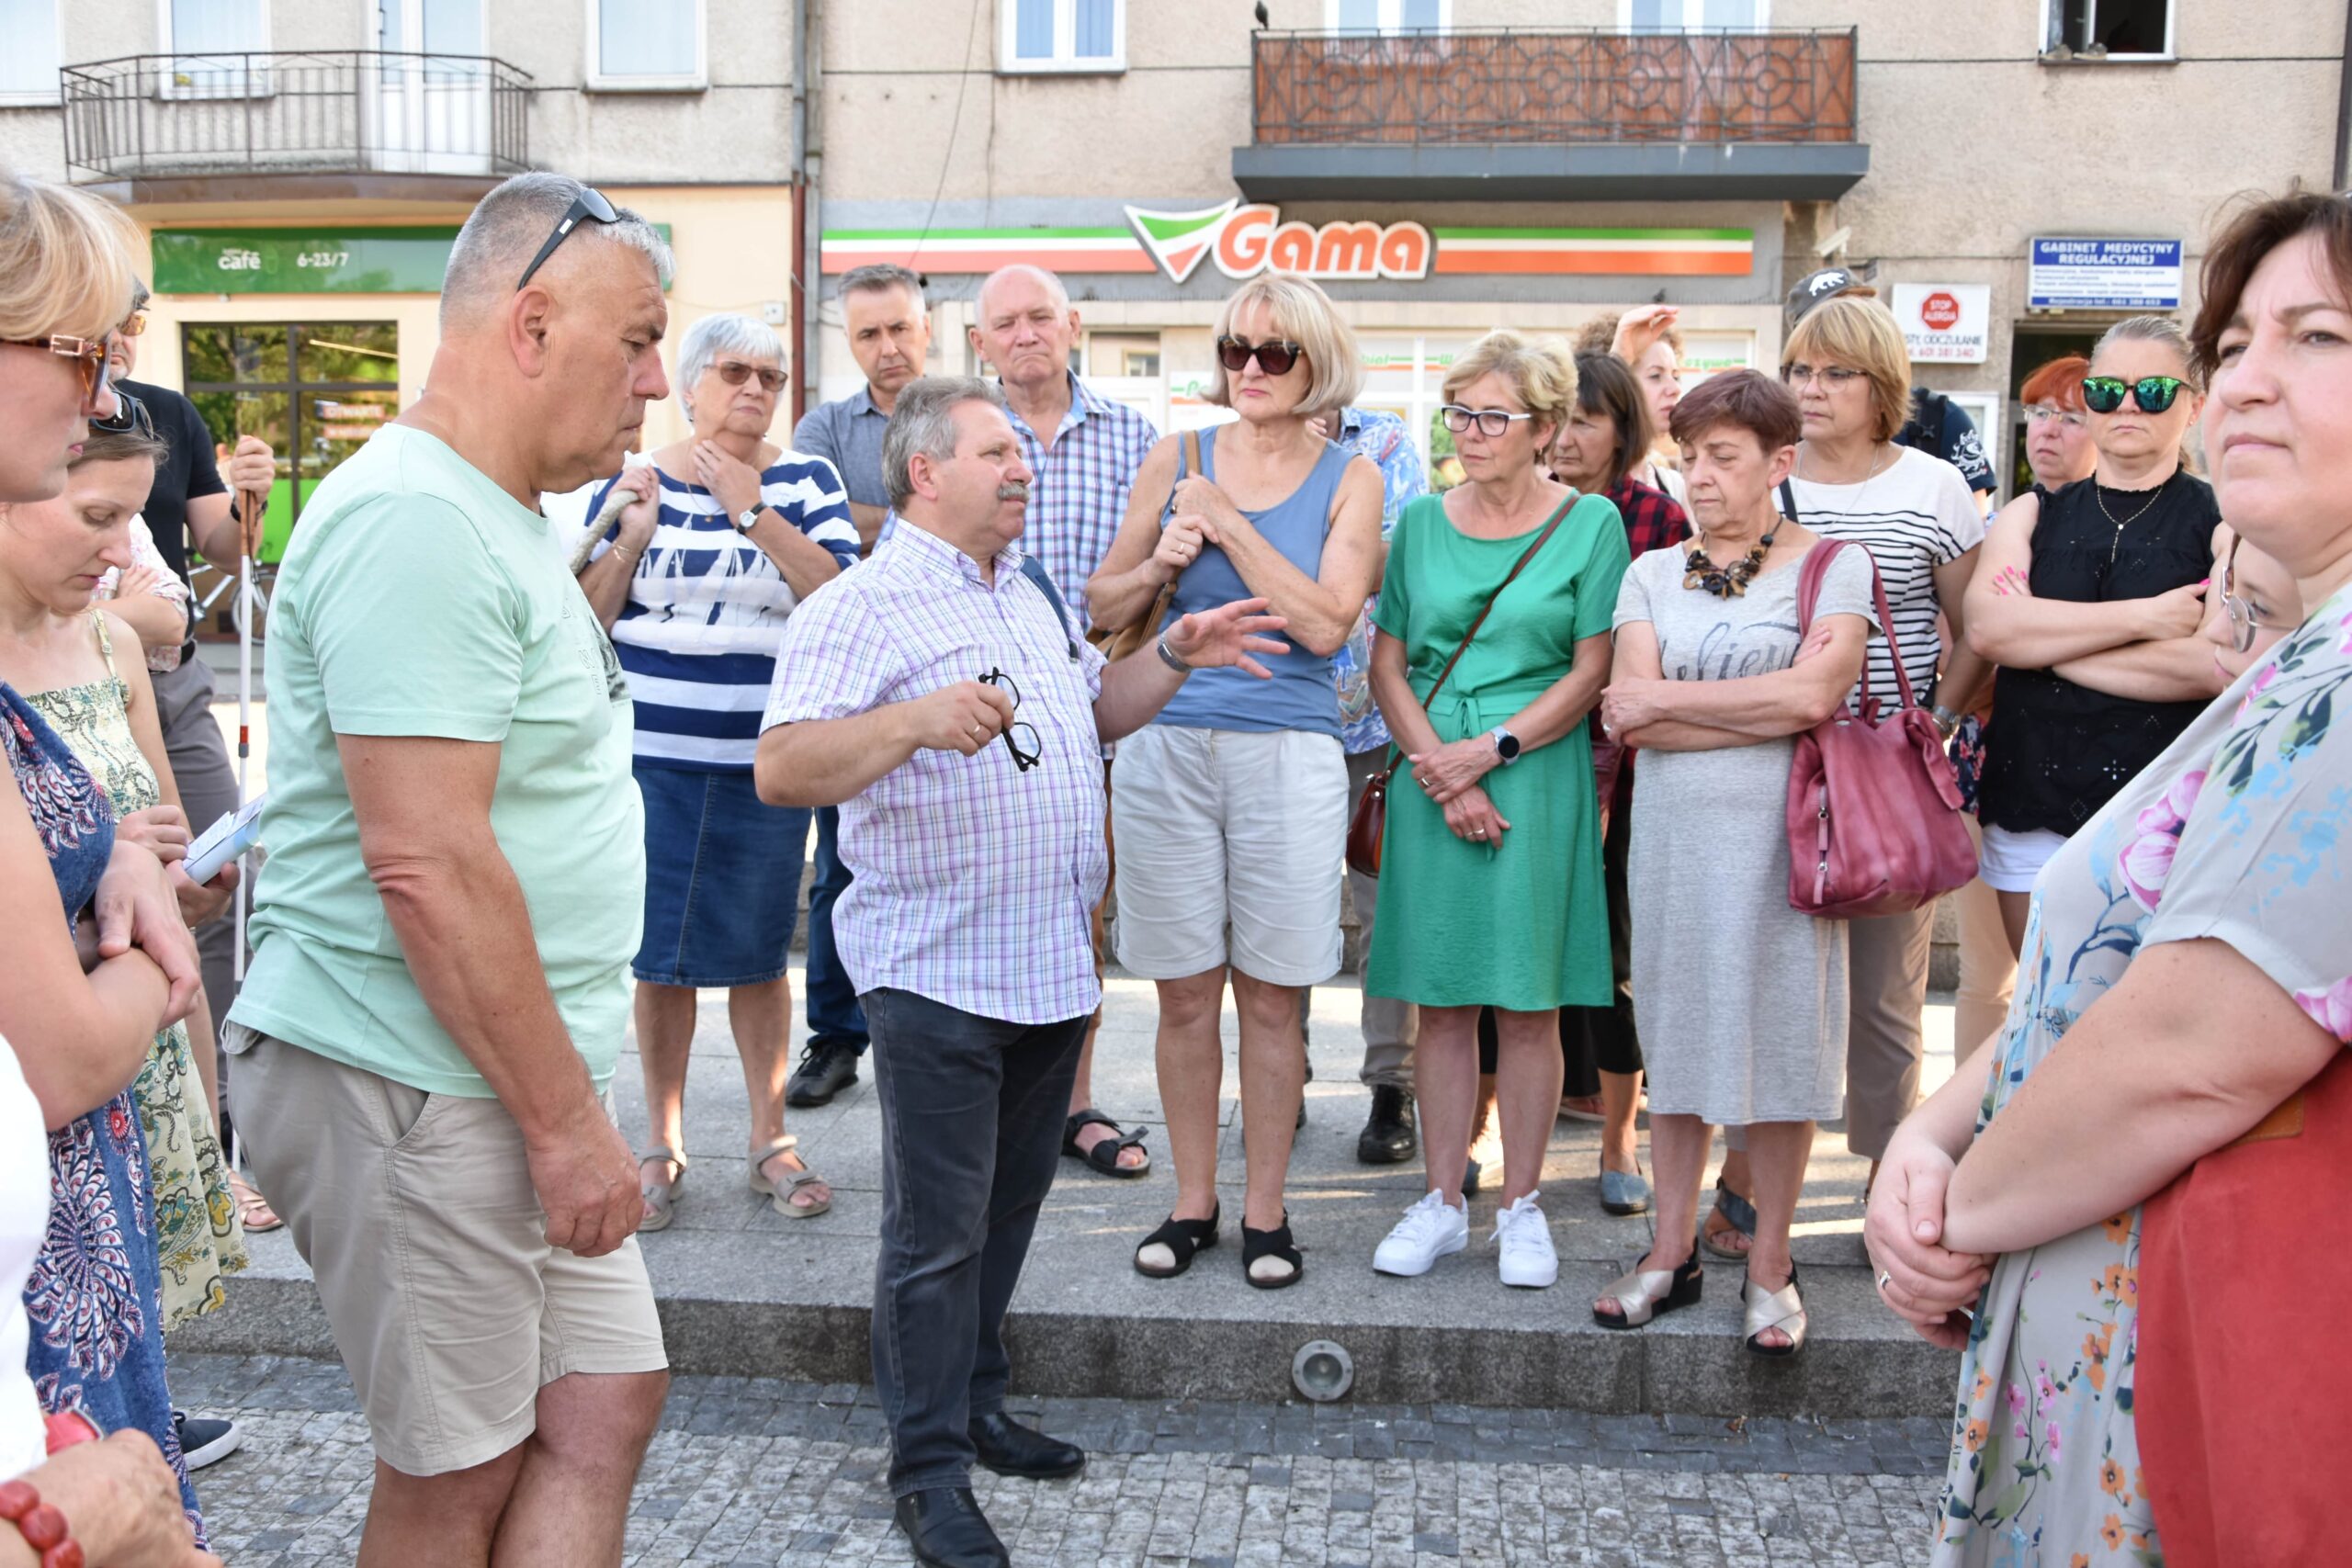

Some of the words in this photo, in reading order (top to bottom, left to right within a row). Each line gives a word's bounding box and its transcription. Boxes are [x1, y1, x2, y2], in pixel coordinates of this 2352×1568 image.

[1219, 209, 1425, 272] Gama
[2041, 243, 2098, 254] GABINET
[2104, 243, 2174, 254] MEDYCYNY
[297, 252, 349, 267] 6-23/7
[2058, 254, 2154, 265] REGULACYJNEJ
[1930, 299, 1952, 310] STOP
[1924, 334, 1982, 345] ODCZULANIE
